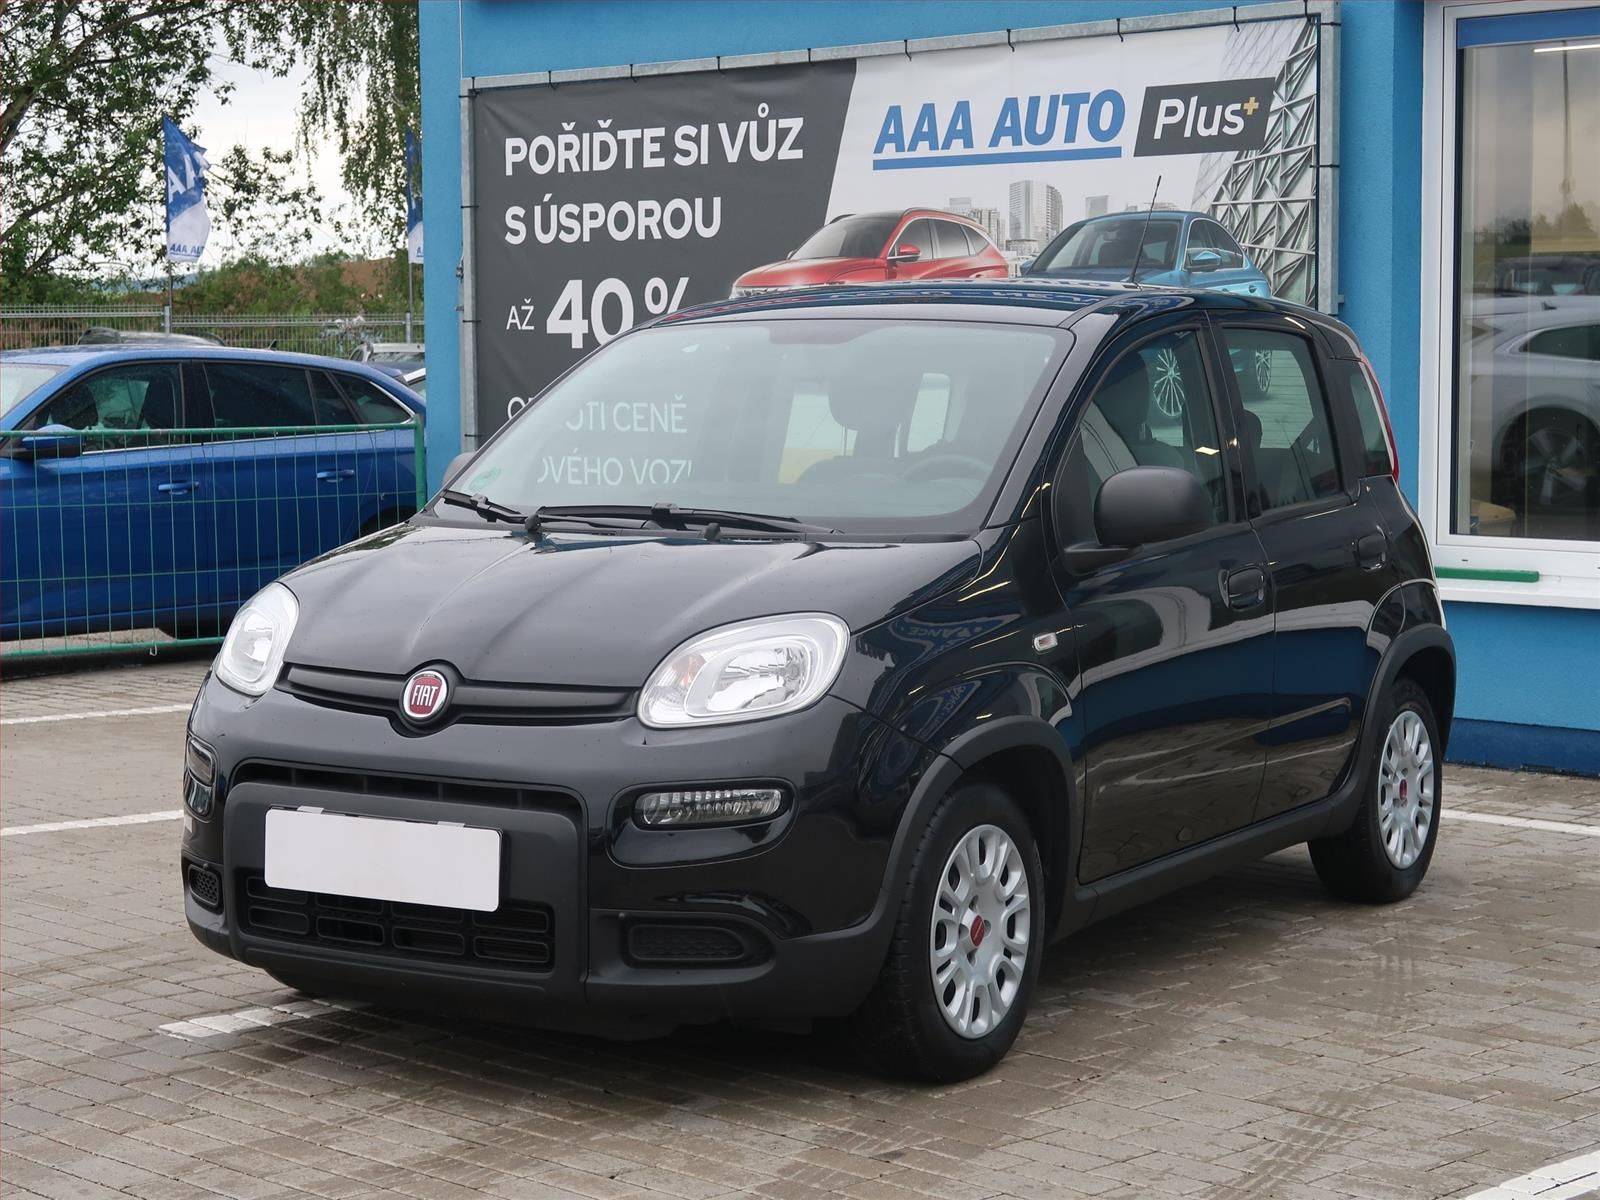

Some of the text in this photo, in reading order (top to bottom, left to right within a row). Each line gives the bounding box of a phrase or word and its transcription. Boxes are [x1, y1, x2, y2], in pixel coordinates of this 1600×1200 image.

[505, 102, 804, 176] POŘIĎTE SI VŮZ
[873, 100, 974, 154] AAA
[988, 89, 1126, 148] AUTO
[504, 193, 721, 245] S ÚSPOROU
[506, 298, 535, 330] AŽ
[613, 393, 688, 433] CENĚ
[411, 684, 439, 707] FIAT
